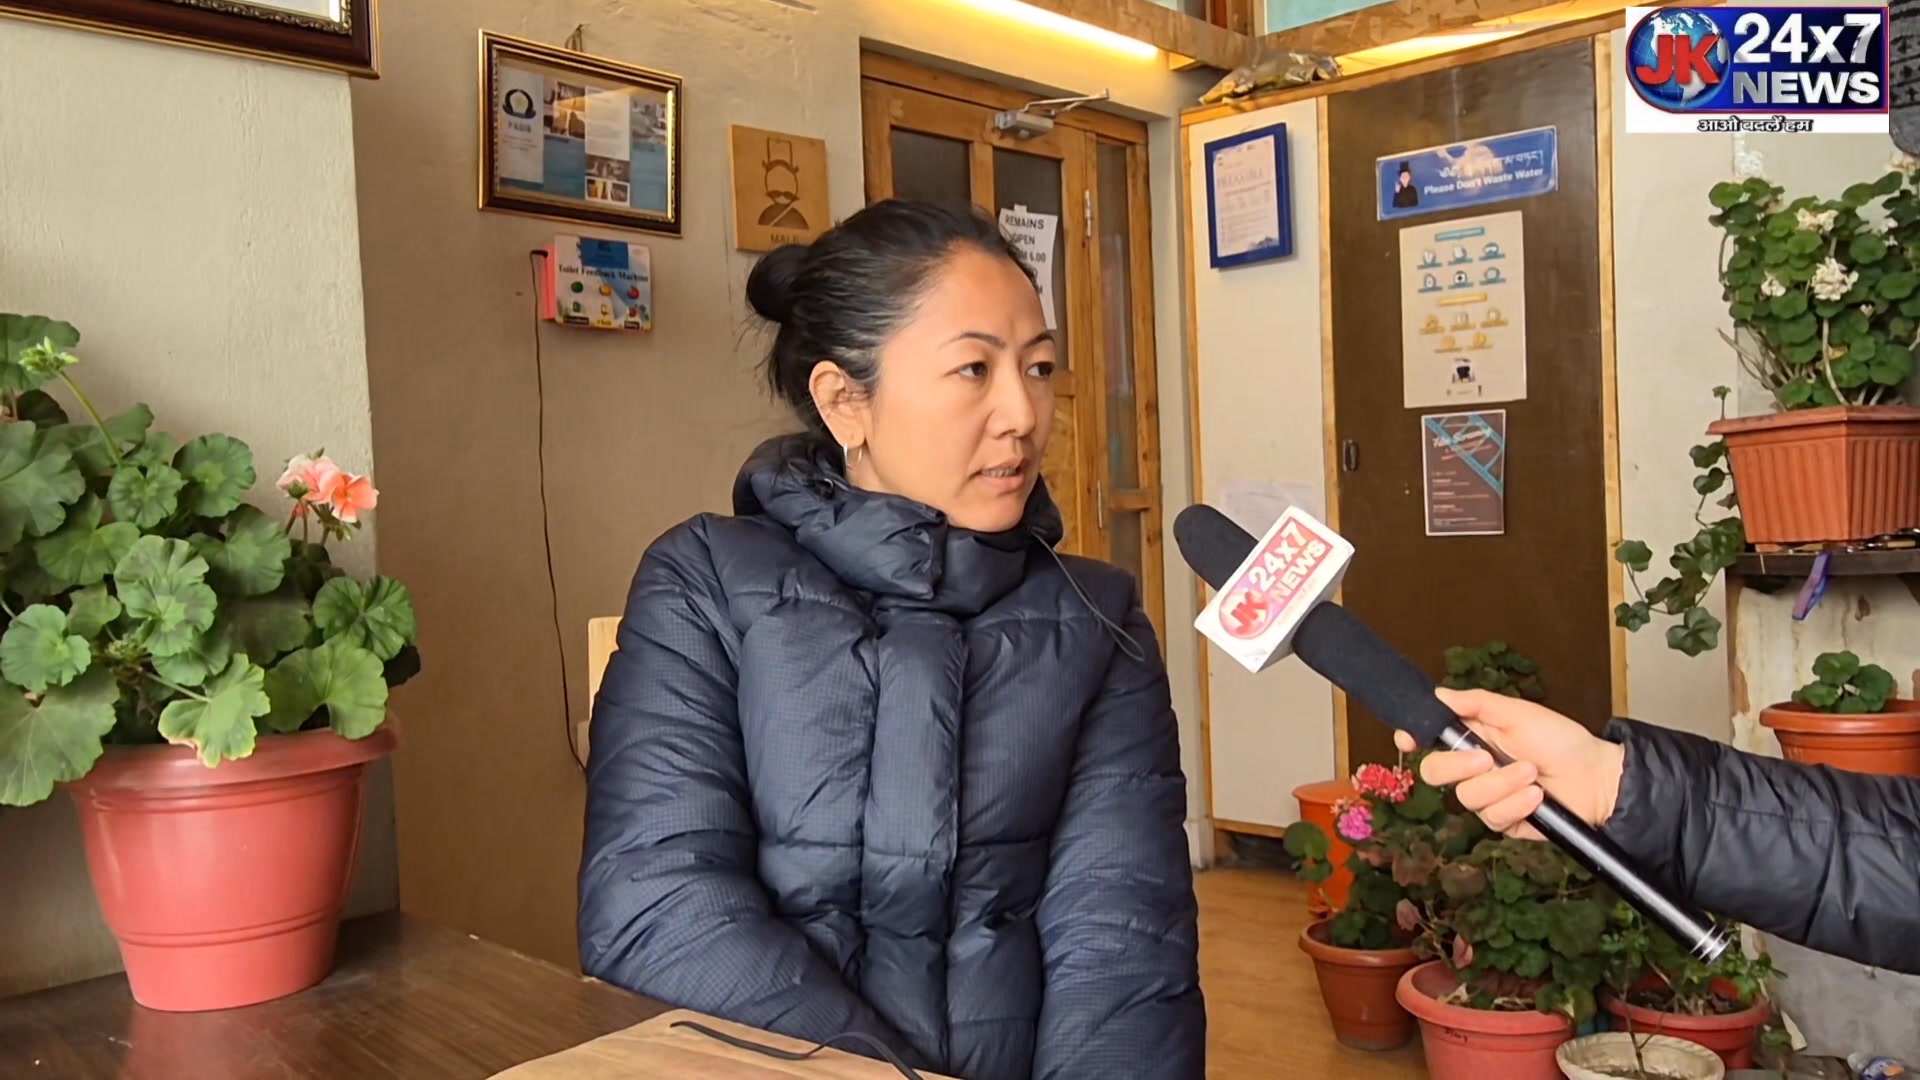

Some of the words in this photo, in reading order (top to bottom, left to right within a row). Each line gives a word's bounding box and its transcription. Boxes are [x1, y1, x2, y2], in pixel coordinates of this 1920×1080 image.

[1424, 183, 1455, 195] Please
[1456, 177, 1482, 190] Don't
[1483, 173, 1513, 185] Waste
[1515, 167, 1544, 180] Water
[1005, 214, 1044, 230] REMAINS
[1012, 233, 1036, 246] OPEN
[1249, 521, 1307, 592] 24x7
[1269, 539, 1327, 603] NEWS
[1230, 591, 1270, 635] JK
